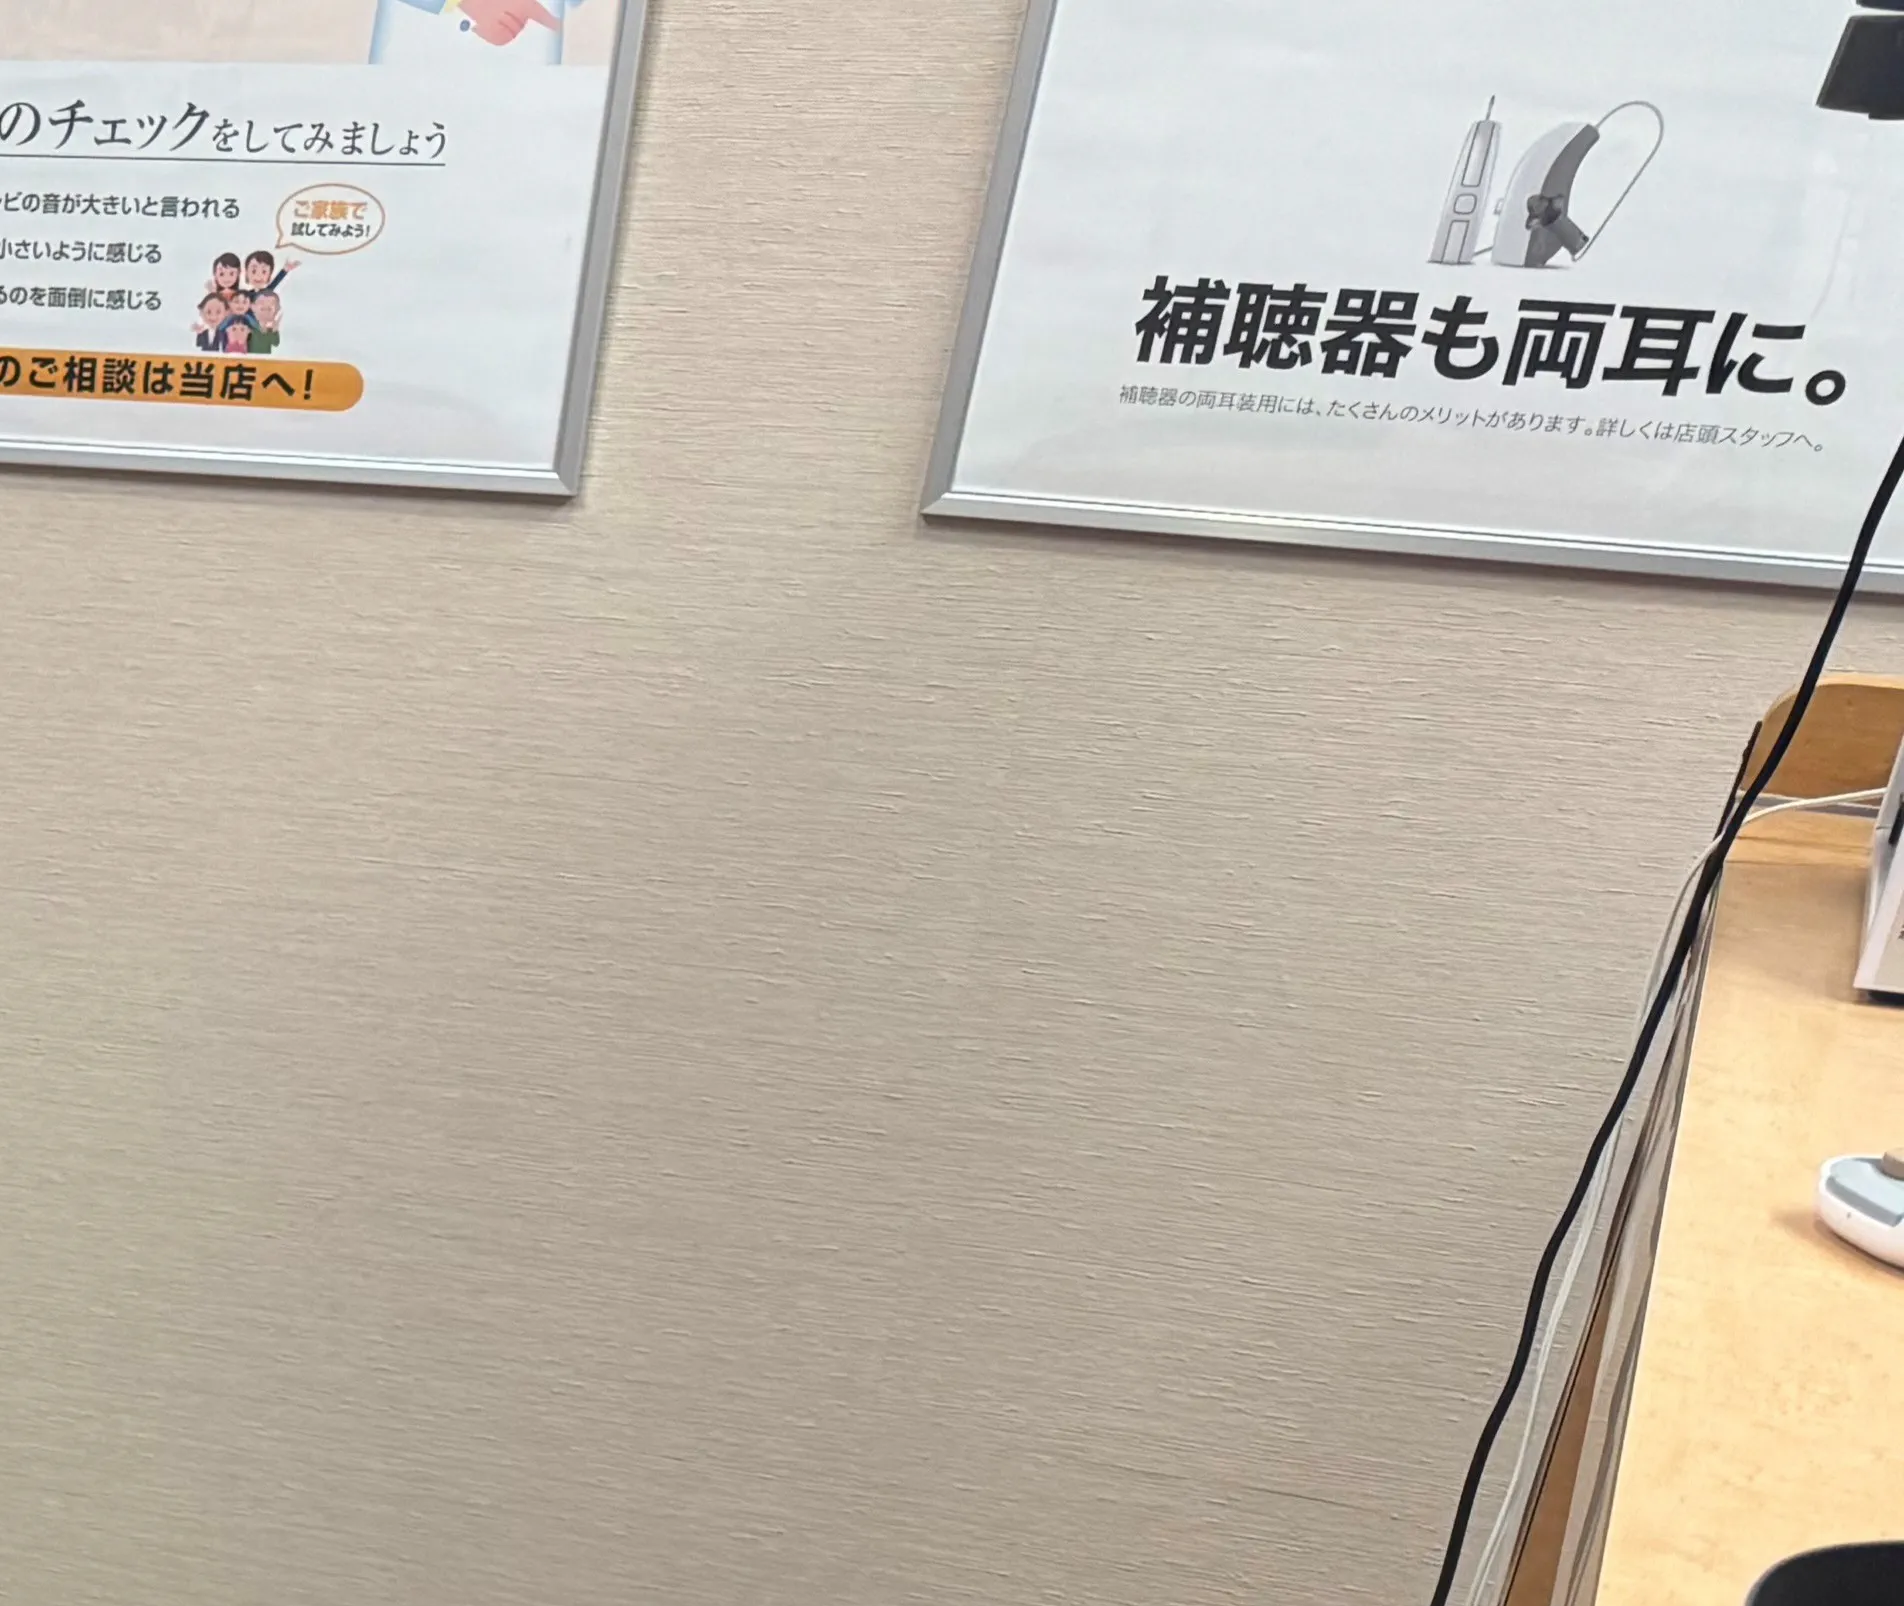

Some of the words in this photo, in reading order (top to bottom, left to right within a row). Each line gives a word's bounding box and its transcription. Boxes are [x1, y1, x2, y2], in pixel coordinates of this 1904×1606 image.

[293, 200, 368, 220] ご家族で
[1135, 274, 1846, 406] 補聴器も両耳に。
[1118, 384, 1824, 452] 補聴器の両耳装用には、たくさんのメリットがあります。詳しくは店頭スタッフへ。
